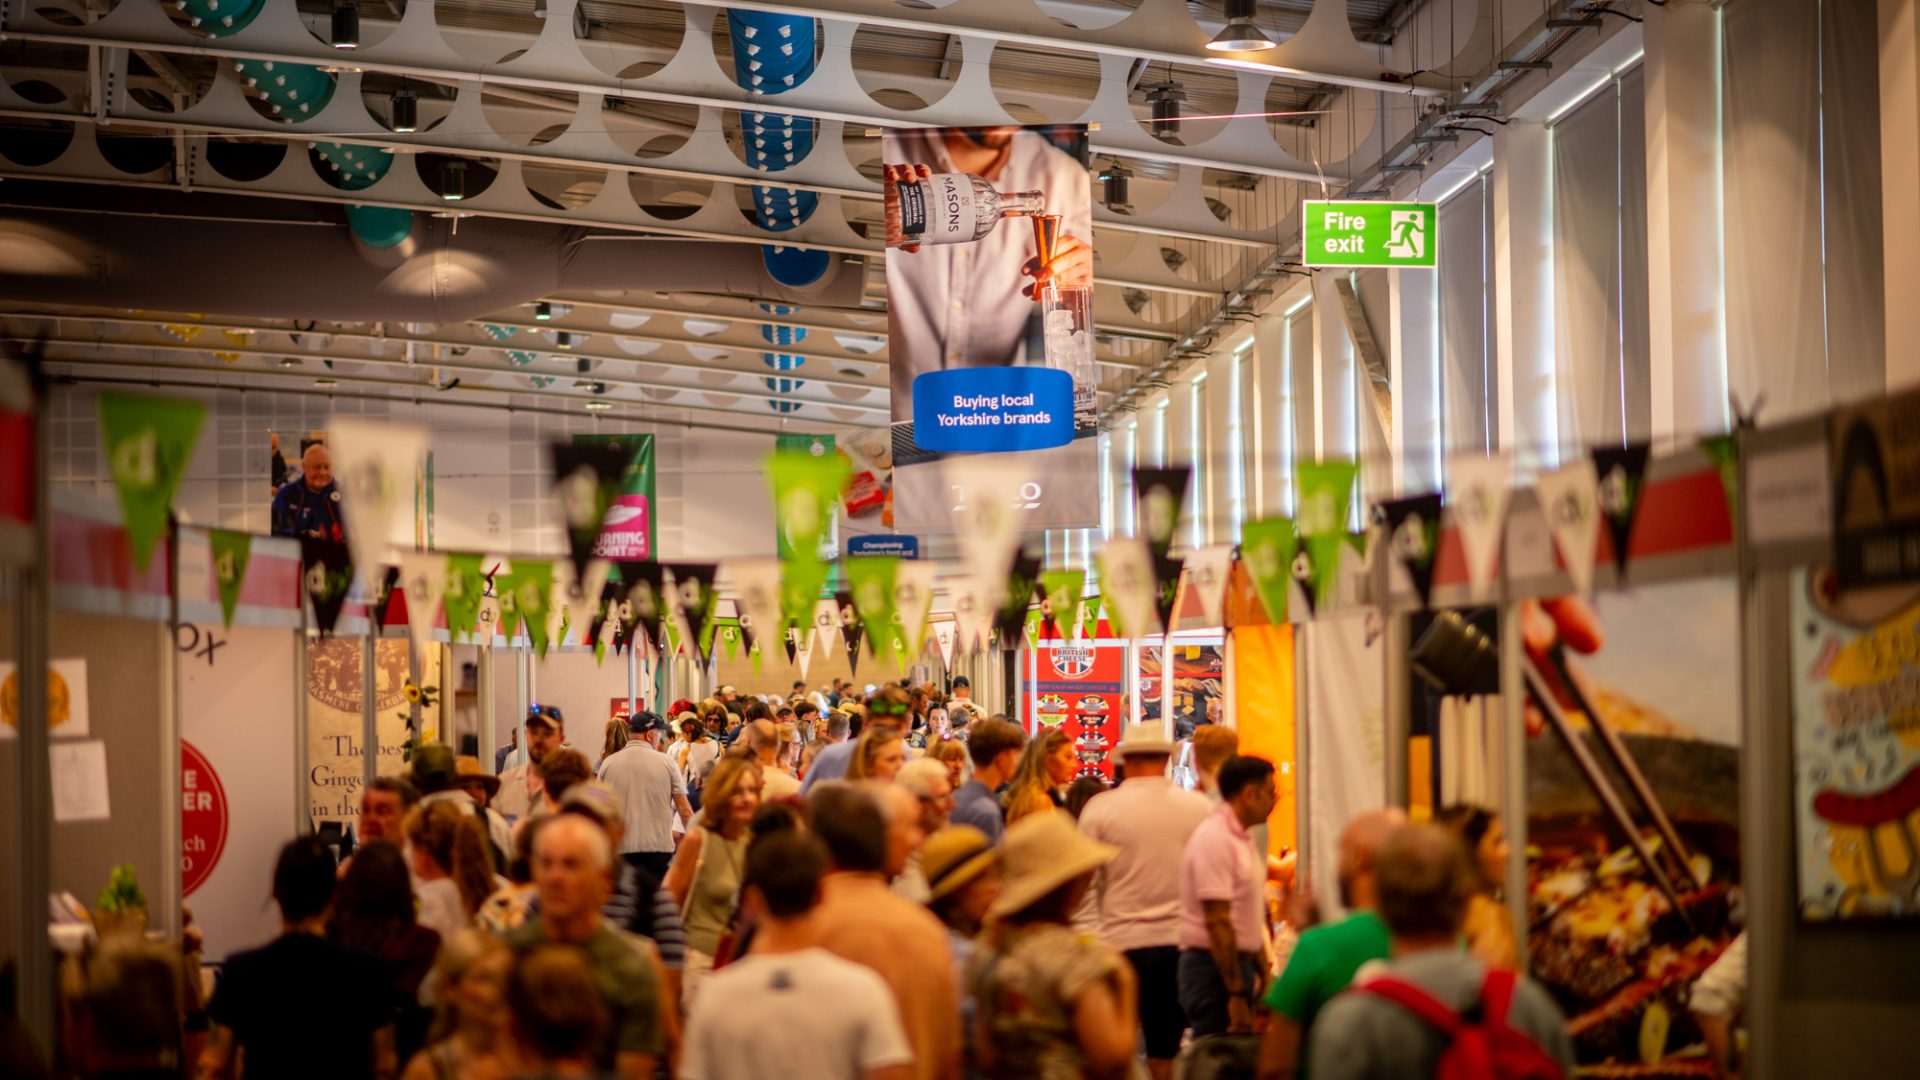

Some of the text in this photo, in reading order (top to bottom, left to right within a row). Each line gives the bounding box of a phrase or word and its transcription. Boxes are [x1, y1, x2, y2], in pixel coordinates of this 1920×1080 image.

[942, 176, 959, 233] MASONS
[1324, 211, 1366, 231] Fire
[1324, 234, 1365, 253] exit
[953, 393, 1034, 410] Buying local
[937, 411, 1051, 426] Yorkshire brands
[595, 531, 645, 546] URNING
[376, 736, 402, 756] bes
[312, 800, 328, 816] in
